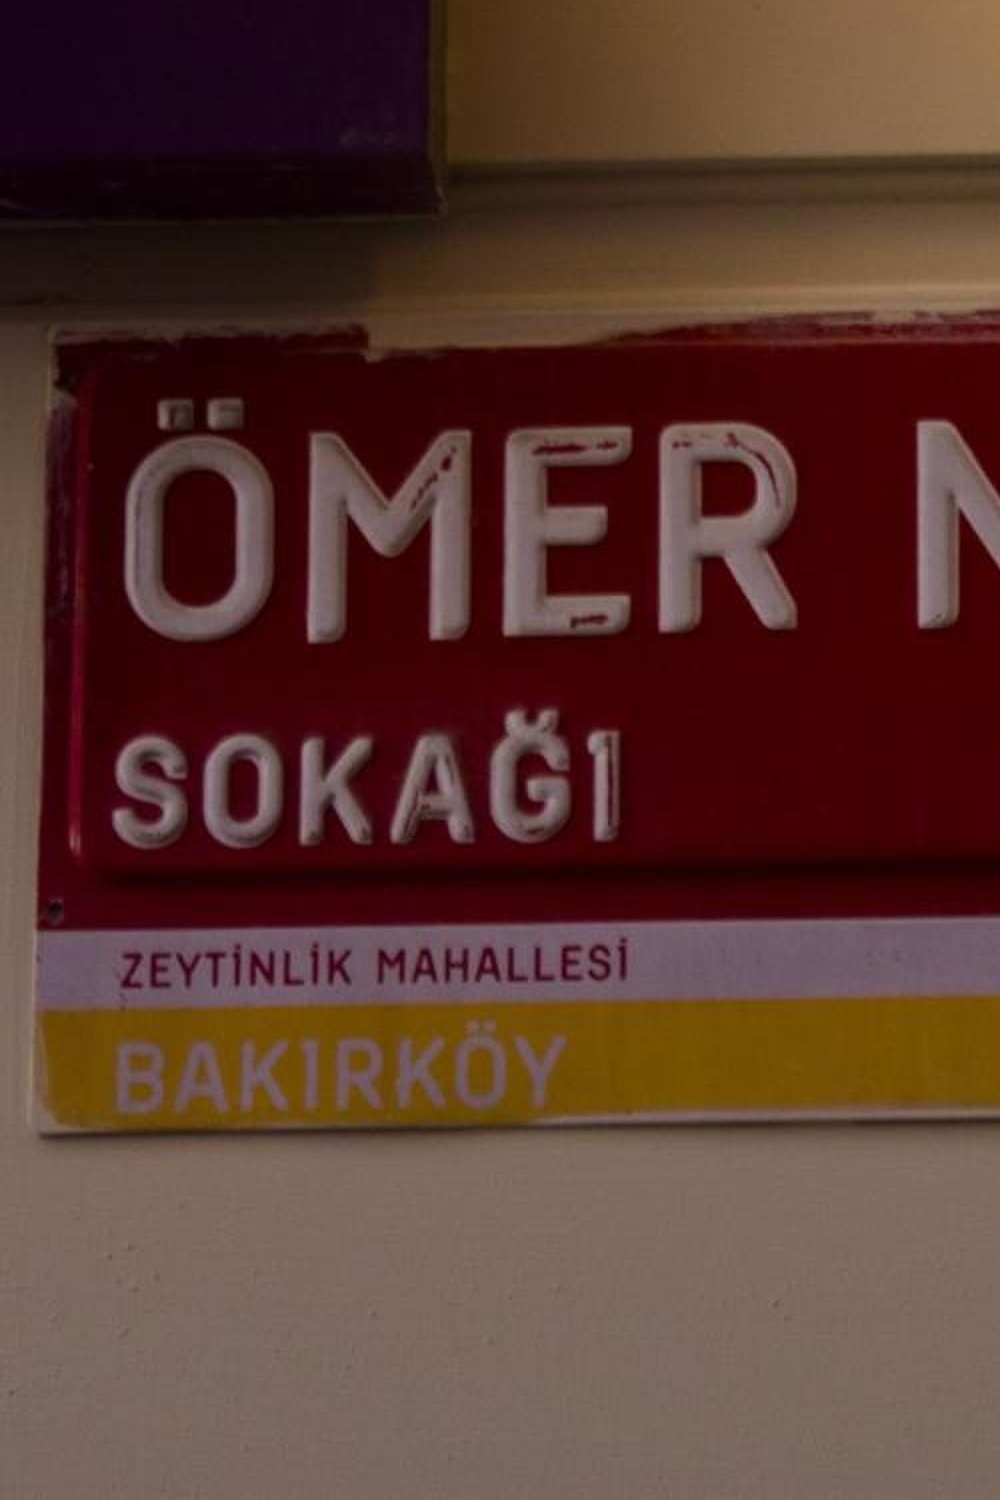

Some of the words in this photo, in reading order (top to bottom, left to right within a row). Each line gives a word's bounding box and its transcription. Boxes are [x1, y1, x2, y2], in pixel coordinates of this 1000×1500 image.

[124, 398, 797, 644] ÖMER
[111, 707, 621, 849] SOKAĞI
[120, 942, 352, 989] ZEYTİNLİK
[377, 938, 629, 985] MAHALLESİ
[115, 1019, 568, 1115] BAKIRKÖY
